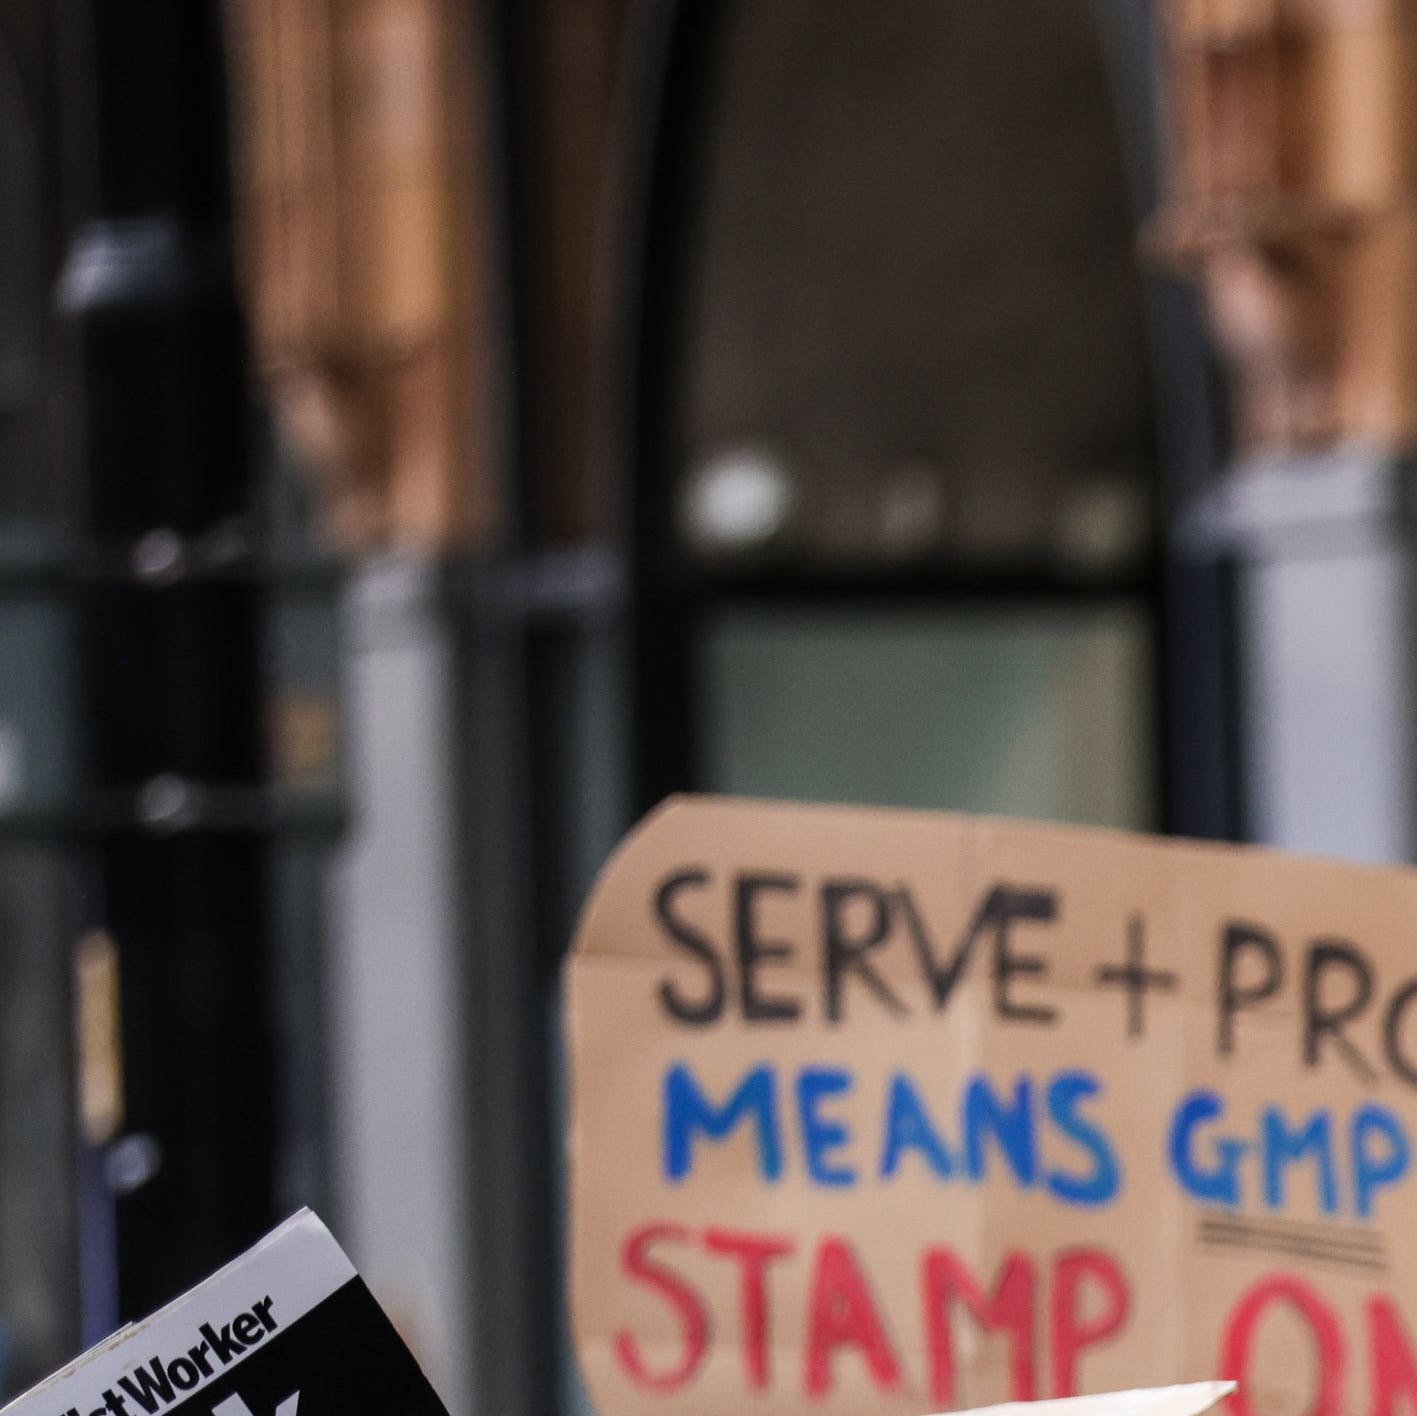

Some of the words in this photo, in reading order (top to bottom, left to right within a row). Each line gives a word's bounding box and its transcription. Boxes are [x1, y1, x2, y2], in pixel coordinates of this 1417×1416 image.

[654, 868, 1060, 1027] SERVE
[1093, 909, 1178, 1044] +
[662, 1058, 1121, 1208] MEANS
[1168, 1088, 1411, 1220] GMP
[614, 1220, 1134, 1404] STAMP
